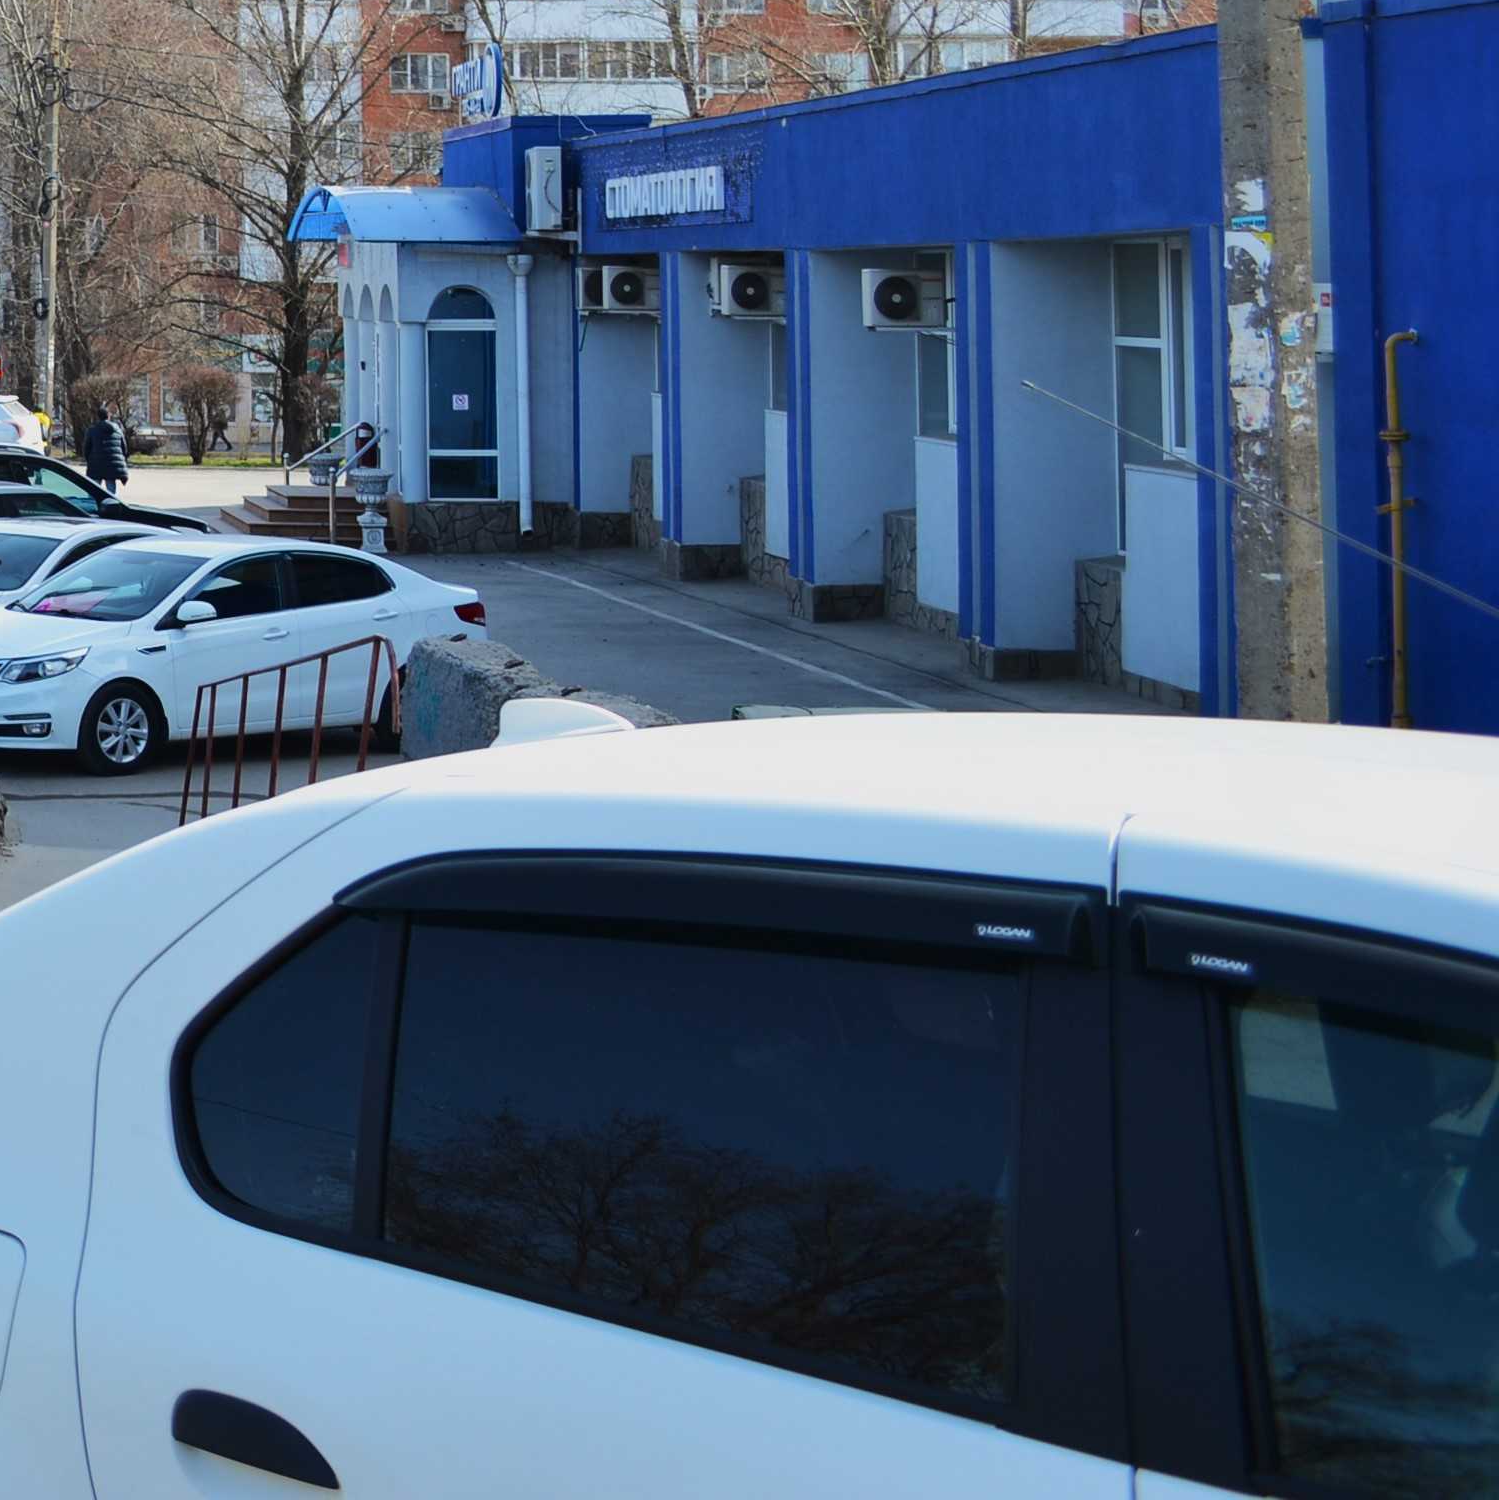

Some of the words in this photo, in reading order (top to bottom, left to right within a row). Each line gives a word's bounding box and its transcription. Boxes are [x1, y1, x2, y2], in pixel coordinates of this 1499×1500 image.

[605, 165, 724, 219] СТОМАТОЛОГИЯ
[987, 925, 1031, 938] LOGAN
[1201, 956, 1248, 972] LOGAN
